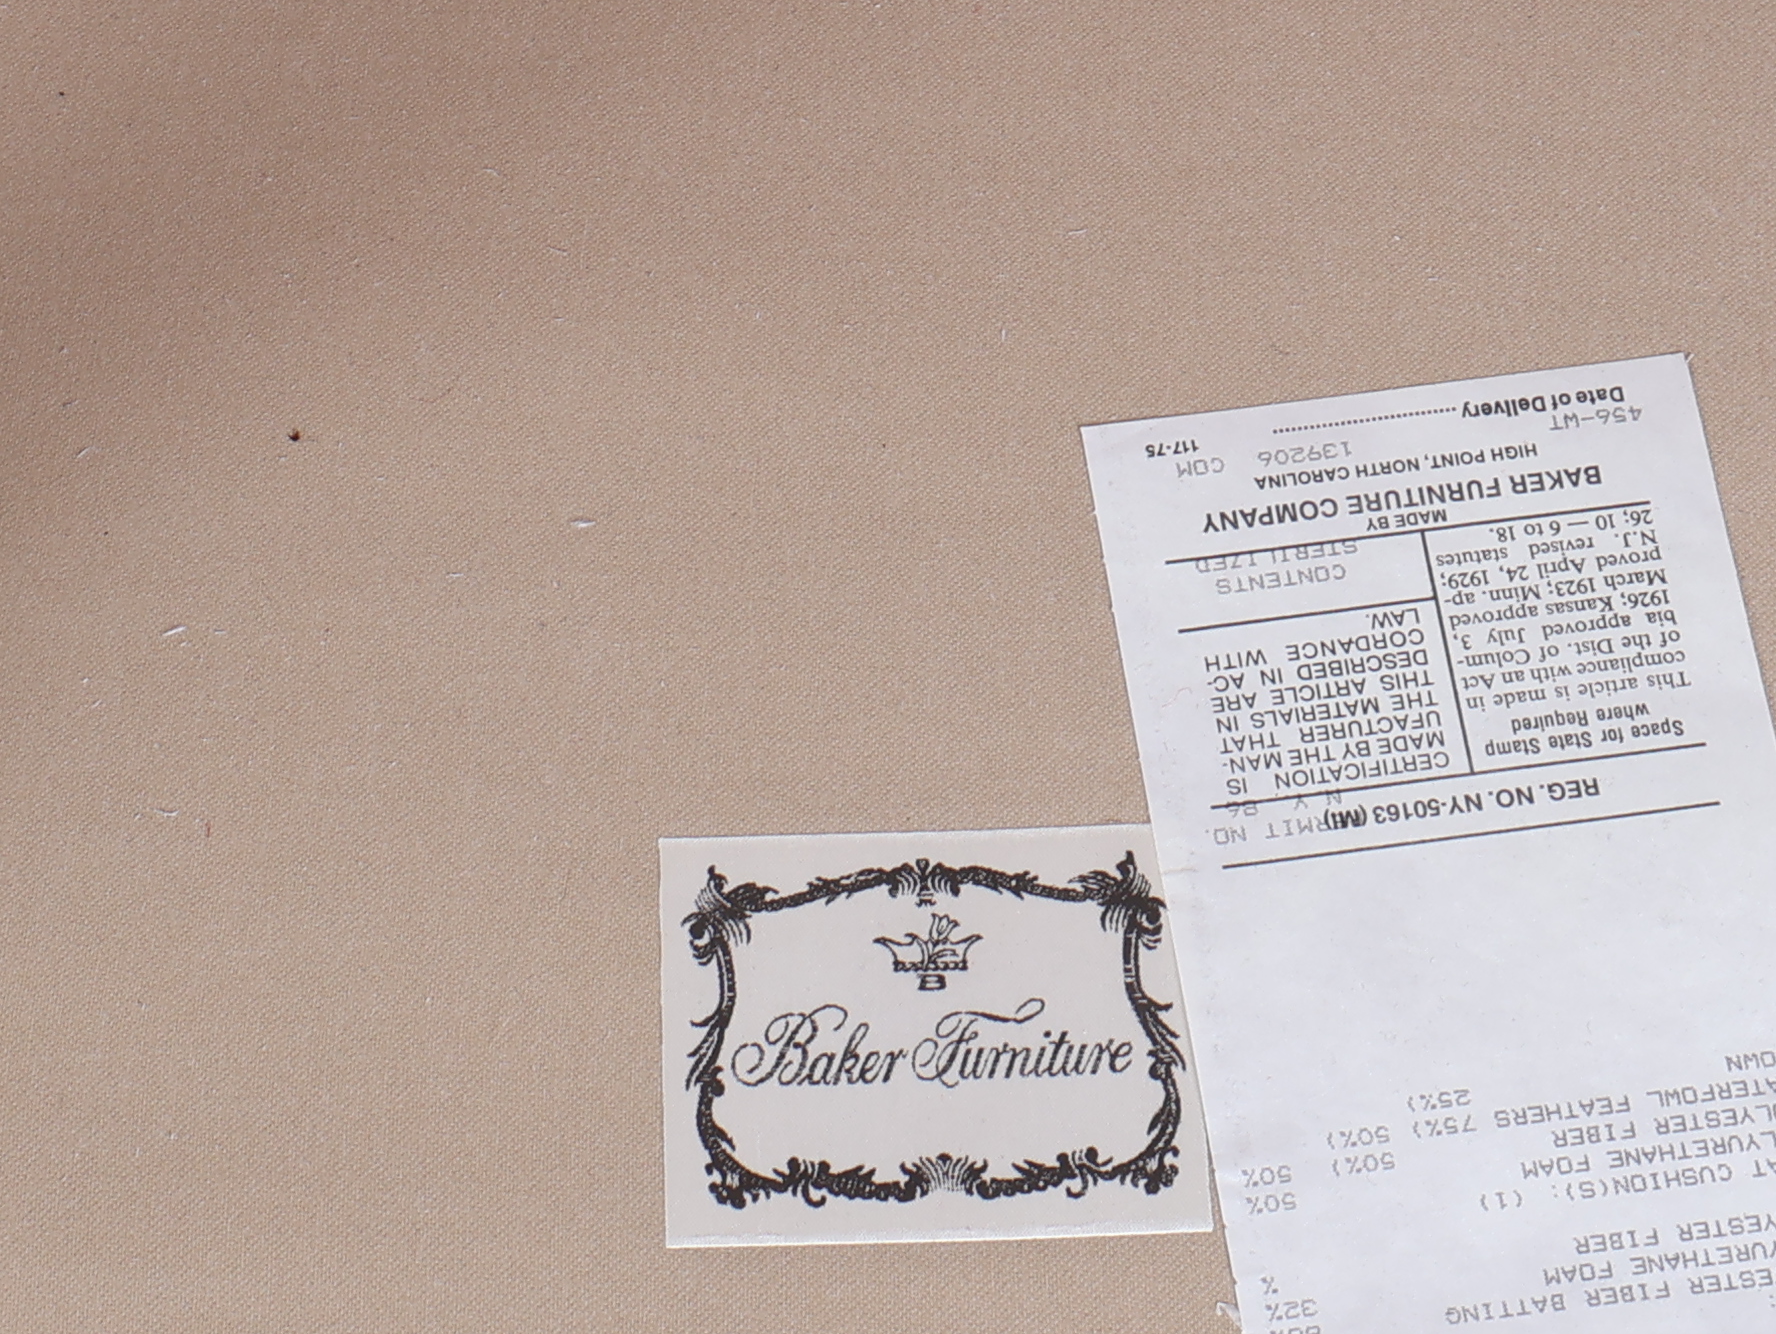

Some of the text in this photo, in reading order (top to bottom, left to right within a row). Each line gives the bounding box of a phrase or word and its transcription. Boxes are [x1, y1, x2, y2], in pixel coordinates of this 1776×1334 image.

[1550, 392, 1572, 411] of
[1575, 386, 1625, 405] Date
[1549, 405, 1643, 432] 456-WT
[1144, 439, 1199, 459] 117-75
[1175, 440, 1353, 479] 139206 COM
[1253, 443, 1538, 490] HIGH POINT, NORTH CAROLINA
[1203, 465, 1602, 534] BAKER FURNITURE COMPANY
[1366, 508, 1448, 532] MADE BY
[1523, 522, 1544, 536] to
[1548, 520, 1561, 537] 6
[1594, 513, 1616, 531] 10
[1622, 509, 1653, 527] 26;
[1435, 529, 1658, 567] N.J. revised statutes
[1489, 525, 1516, 543] 18.
[1214, 563, 1347, 595] CONTENTS
[1440, 545, 1663, 590] proved April 24, 1929;
[1444, 568, 1668, 606] March 1923; Minn. ap-
[1365, 607, 1421, 630] LAW.
[1448, 588, 1670, 632] 1926; Kansas approved
[1452, 609, 1678, 651] bia approved July 3,
[1204, 628, 1425, 673] CORDANCE WITH
[1457, 629, 1681, 669] of the Dist. of Colum-
[1207, 648, 1429, 693] DESCRIBED IN AC-
[1460, 650, 1686, 691] compliance with an Act
[1210, 669, 1435, 714] THIS ARTICLE ARE
[1465, 671, 1692, 712] This article is made in
[1215, 690, 1439, 734] THE MATERIALS IN
[1510, 702, 1650, 735] where Required
[1220, 710, 1442, 755] UFACTURER THAT
[1484, 717, 1685, 757] Space for State Stamp
[1222, 730, 1445, 774] MADE BY THE MAN-
[1226, 751, 1450, 796] CERTIFICATION IS
[1488, 785, 1535, 808] NO.
[1539, 777, 1600, 802] REG.
[1372, 792, 1483, 824] NY-50163
[1204, 825, 1248, 846] NO.
[917, 973, 947, 992] B
[730, 997, 1134, 1088] Baker Furniture
[1406, 1088, 1472, 1113] 25%)
[1493, 1094, 1632, 1129] FEATHERS
[1326, 1125, 1391, 1151] 50%)
[1412, 1114, 1478, 1139] 75%)
[1551, 1120, 1637, 1149] FIBER
[1241, 1164, 1292, 1188] 50%
[1331, 1151, 1396, 1178] 50%)
[1520, 1153, 1591, 1180] FOAM
[1551, 1163, 1733, 1202] CUSHION(S):
[1245, 1191, 1297, 1215] 50%
[1479, 1189, 1523, 1212] (1)
[1572, 1227, 1660, 1255] FIBER
[1542, 1260, 1614, 1287] FOAM
[1583, 1280, 1671, 1308] FIBER
[1264, 1298, 1319, 1323] 32%
[1444, 1293, 1567, 1325] BATTING
